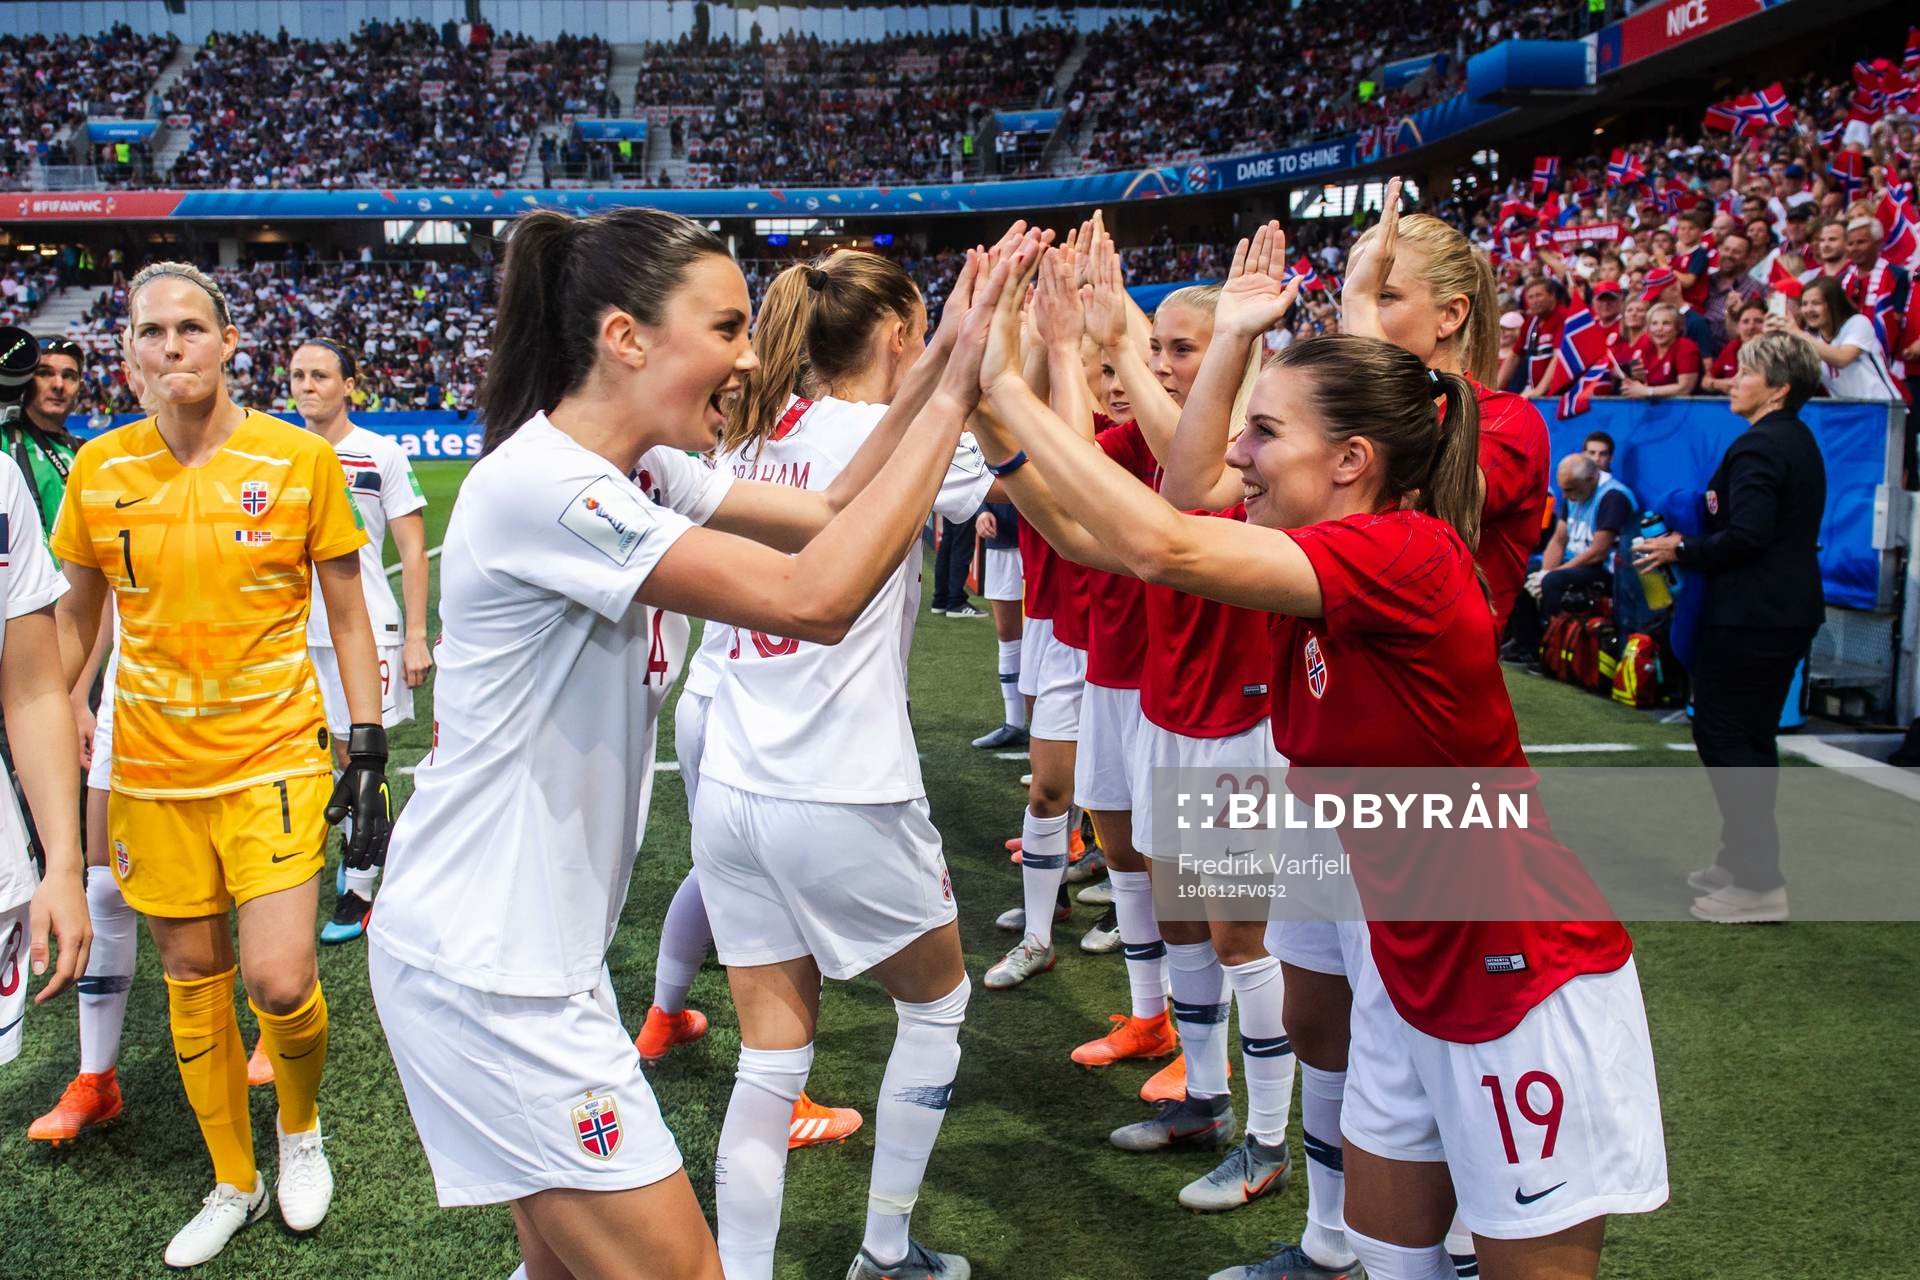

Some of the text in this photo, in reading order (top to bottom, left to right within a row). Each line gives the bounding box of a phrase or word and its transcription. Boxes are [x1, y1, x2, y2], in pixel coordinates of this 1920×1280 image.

[1666, 0, 1709, 37] NICE
[1237, 146, 1342, 181] DARE TO SHINE
[32, 199, 103, 213] #FIFAWWC
[118, 528, 137, 588] 1
[272, 778, 292, 834] 1
[1480, 1070, 1564, 1164] 19
